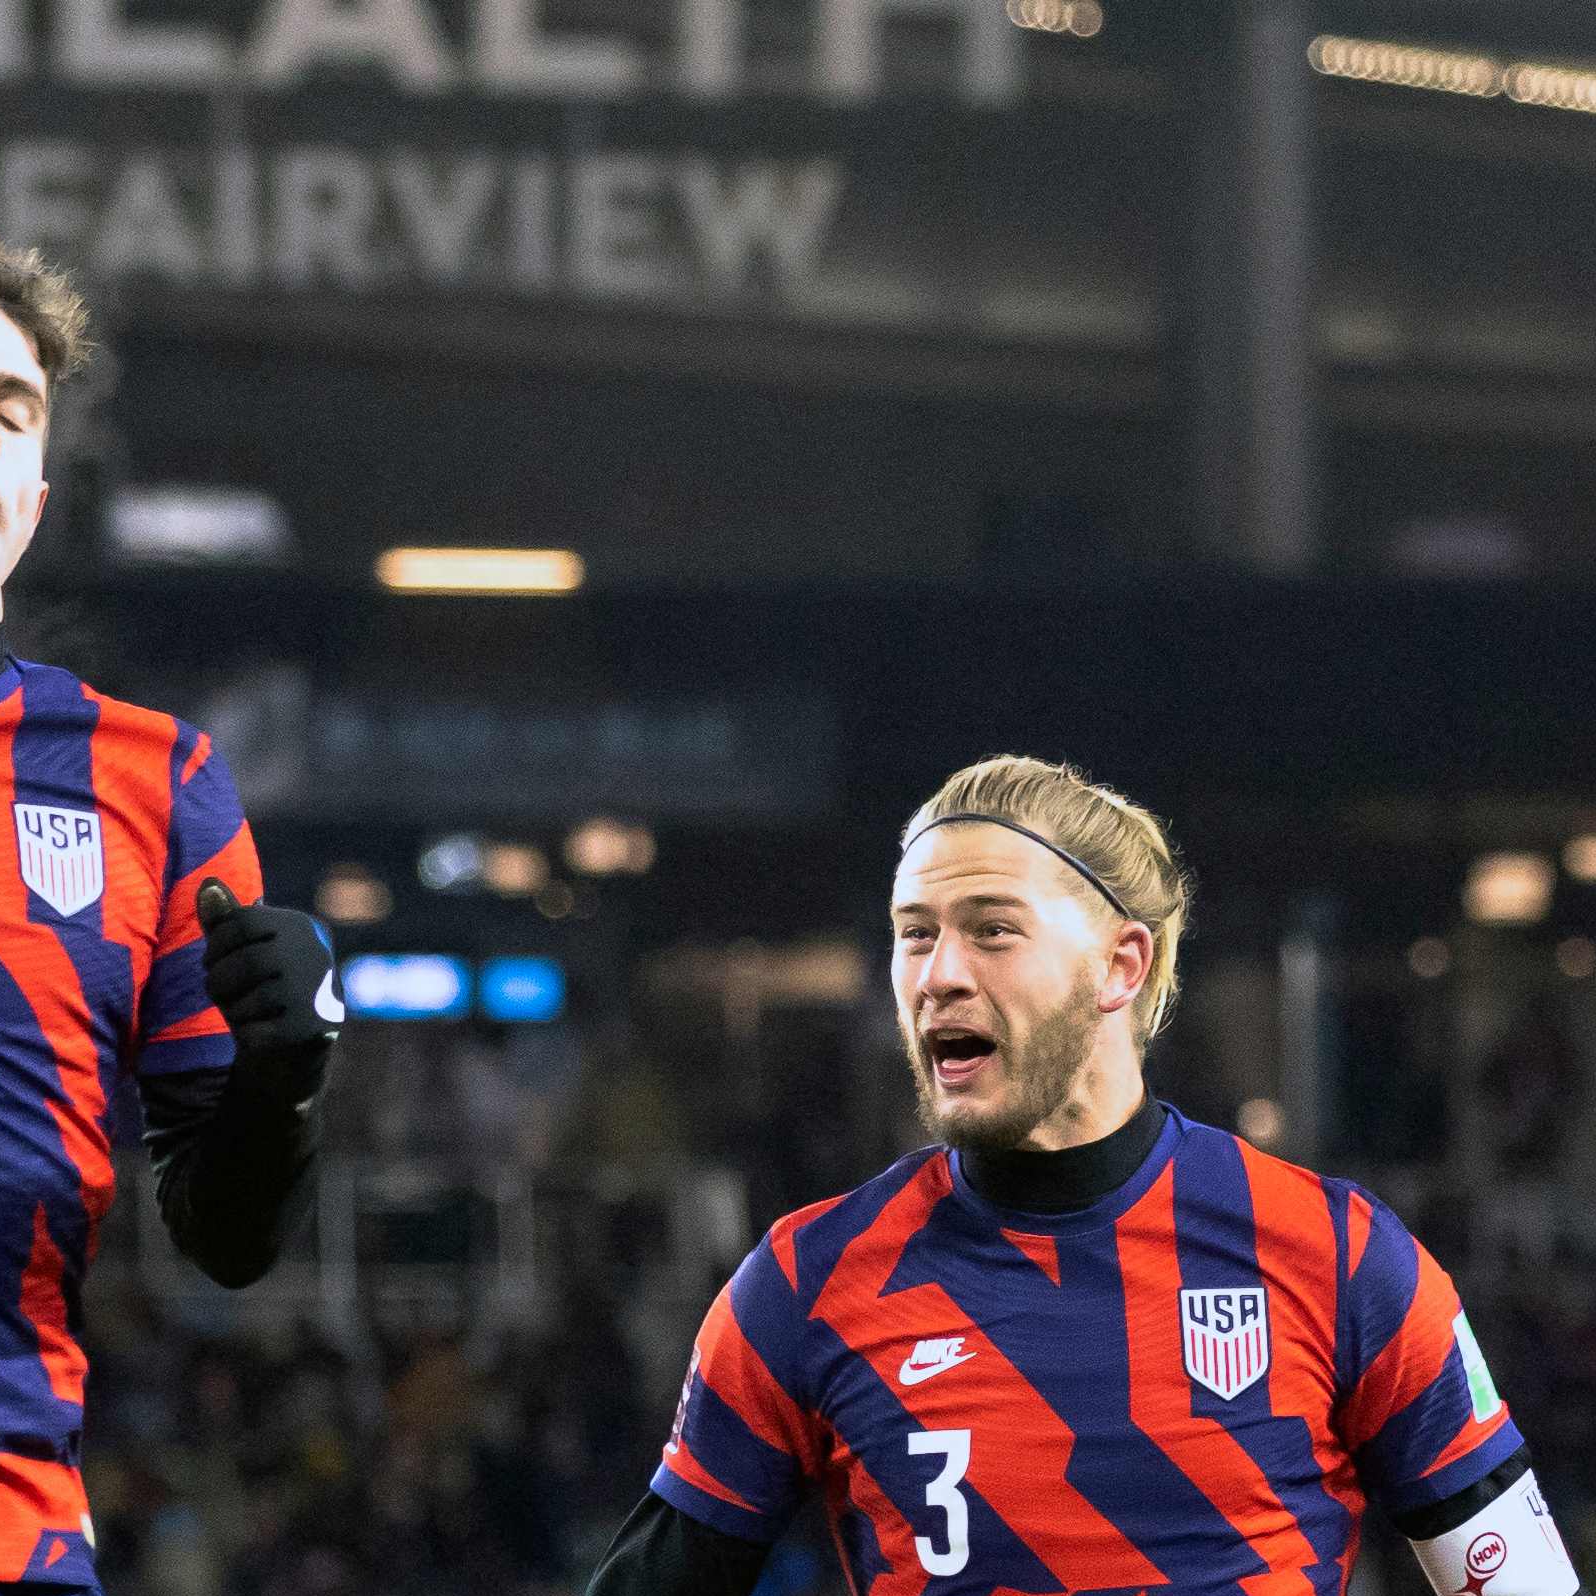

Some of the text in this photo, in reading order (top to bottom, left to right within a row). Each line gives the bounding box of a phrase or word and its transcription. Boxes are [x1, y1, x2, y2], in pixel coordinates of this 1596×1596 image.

[23, 810, 93, 849] USA
[1188, 1294, 1259, 1334] USA
[910, 1337, 966, 1365] NIKE
[907, 1428, 972, 1577] 3
[1473, 1540, 1502, 1566] HON
